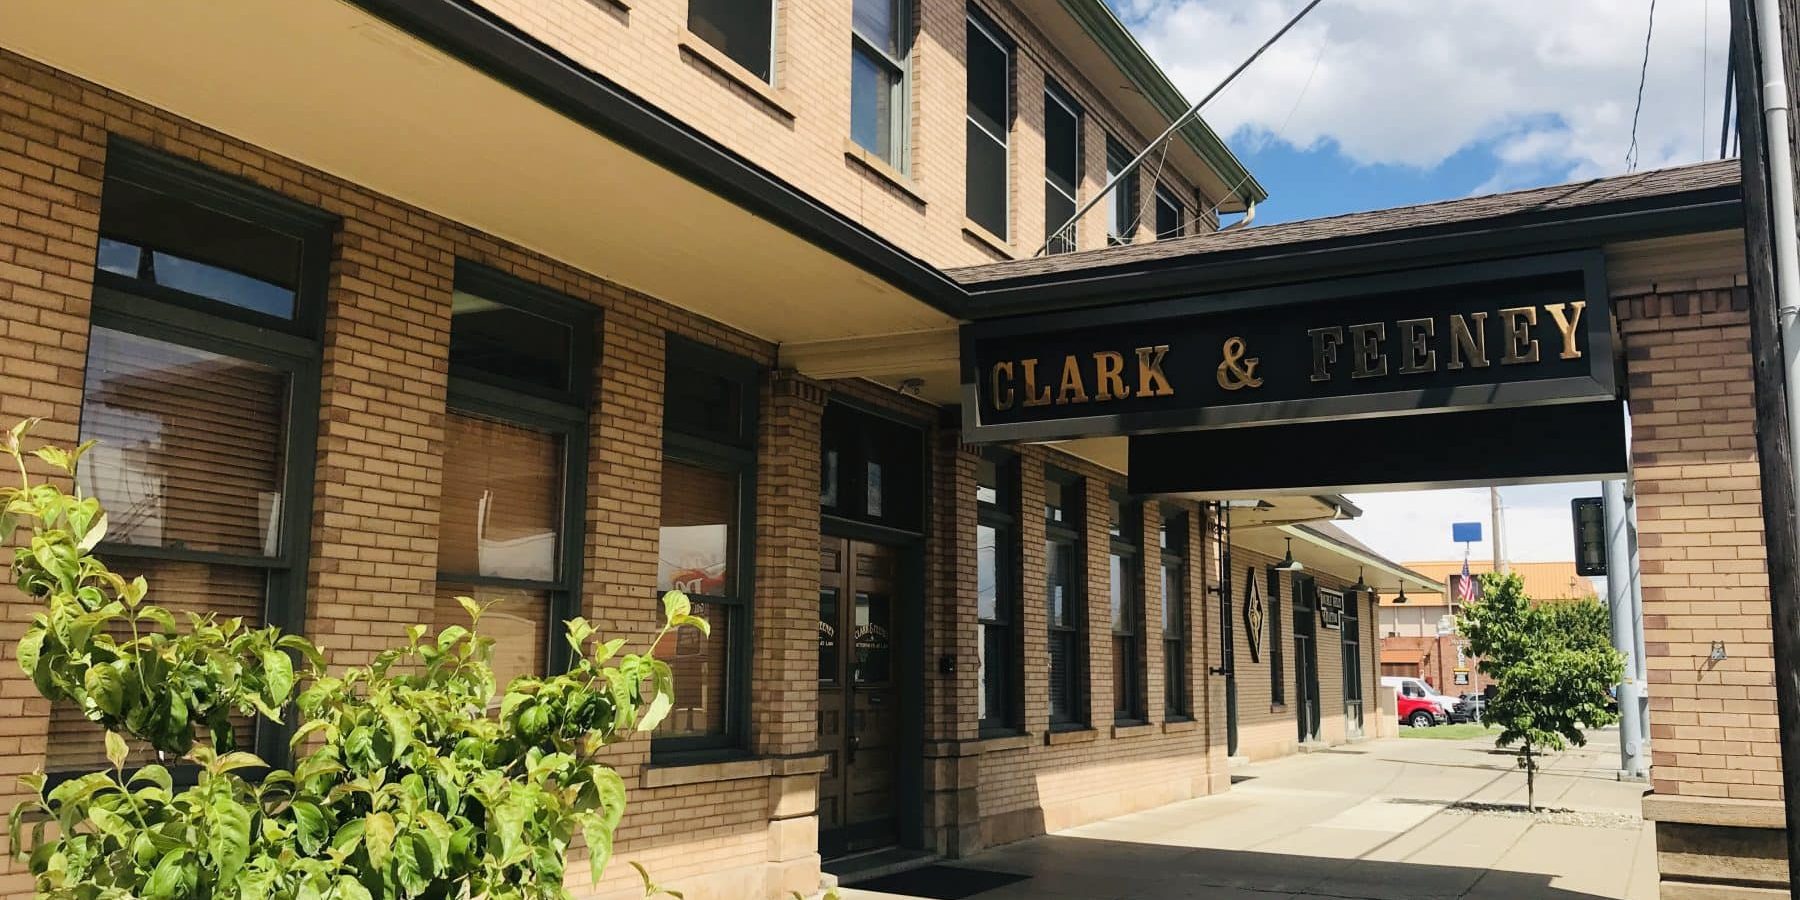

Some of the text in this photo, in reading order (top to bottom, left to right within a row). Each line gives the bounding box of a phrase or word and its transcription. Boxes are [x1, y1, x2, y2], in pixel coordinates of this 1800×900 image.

[991, 301, 1586, 411] CLARK & FEENEY
